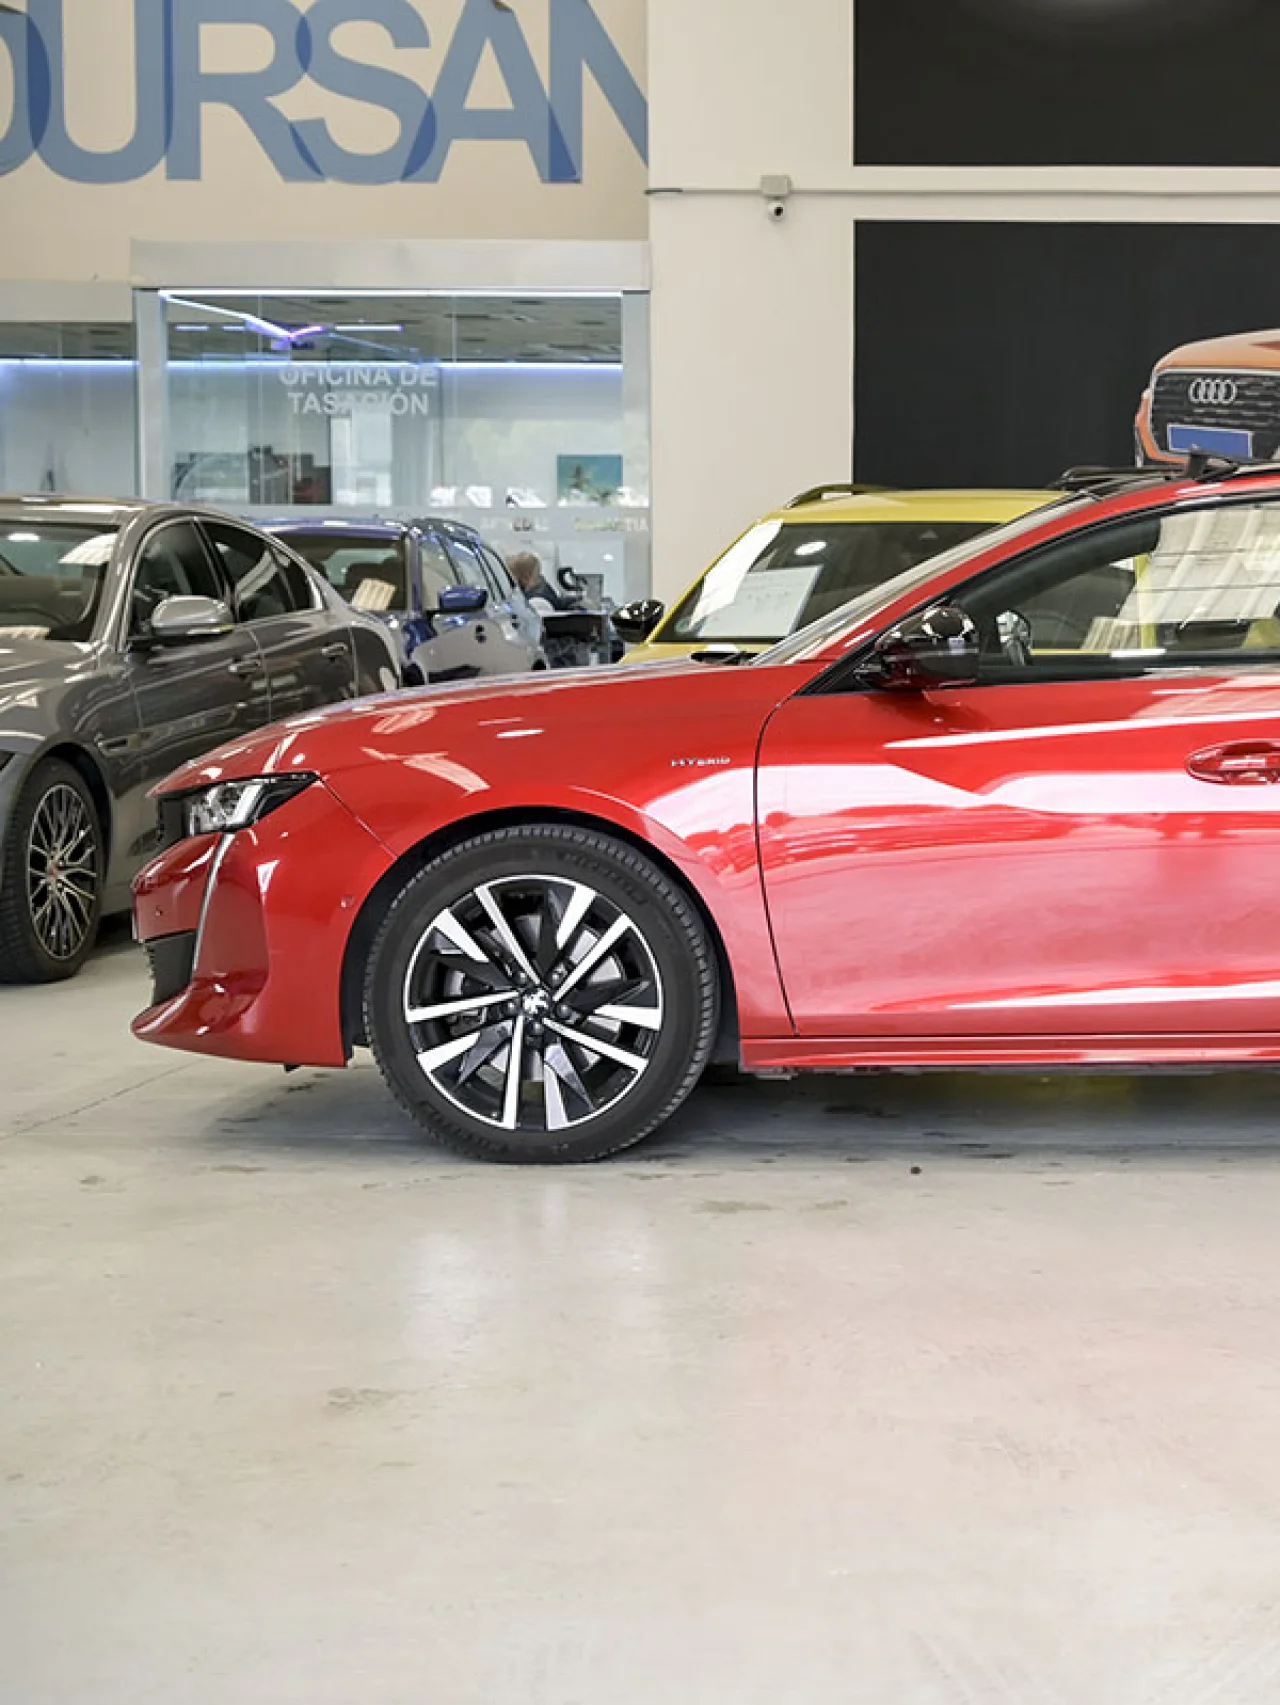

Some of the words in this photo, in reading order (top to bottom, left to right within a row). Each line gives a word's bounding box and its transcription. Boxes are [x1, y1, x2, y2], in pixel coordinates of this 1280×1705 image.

[279, 366, 393, 387] OFICINA
[400, 367, 438, 387] DE
[287, 389, 430, 415] TASACIÓN
